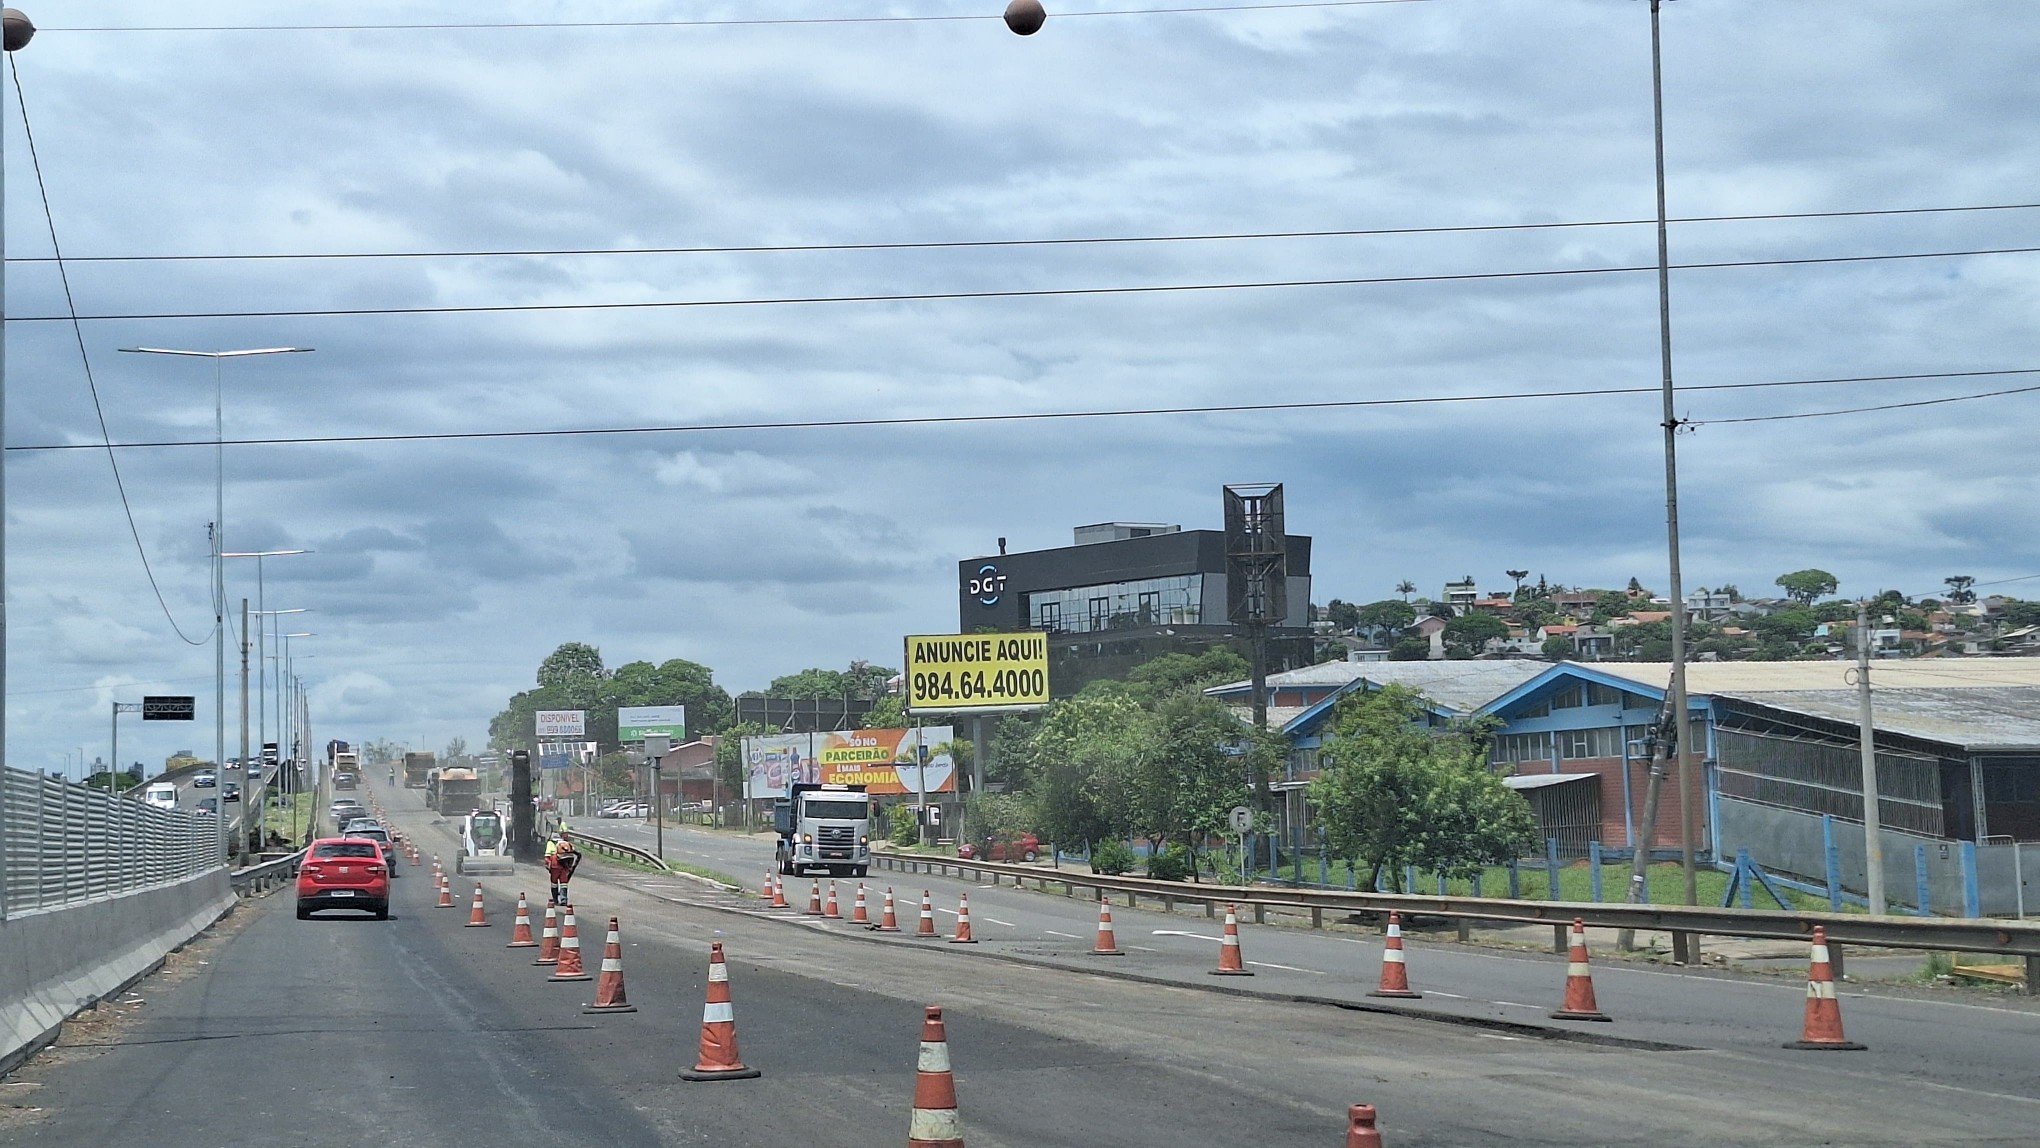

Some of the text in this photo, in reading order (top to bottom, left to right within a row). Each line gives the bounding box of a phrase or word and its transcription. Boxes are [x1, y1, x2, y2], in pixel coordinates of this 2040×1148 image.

[970, 576, 1007, 594] DGT
[915, 639, 1043, 663] ANUNCIE AQUI!
[914, 669, 1044, 700] 984.64.4000
[850, 735, 877, 747] SÓ NO
[825, 747, 889, 761] PARCEIRÃO
[829, 771, 899, 784] ECONOMIA
